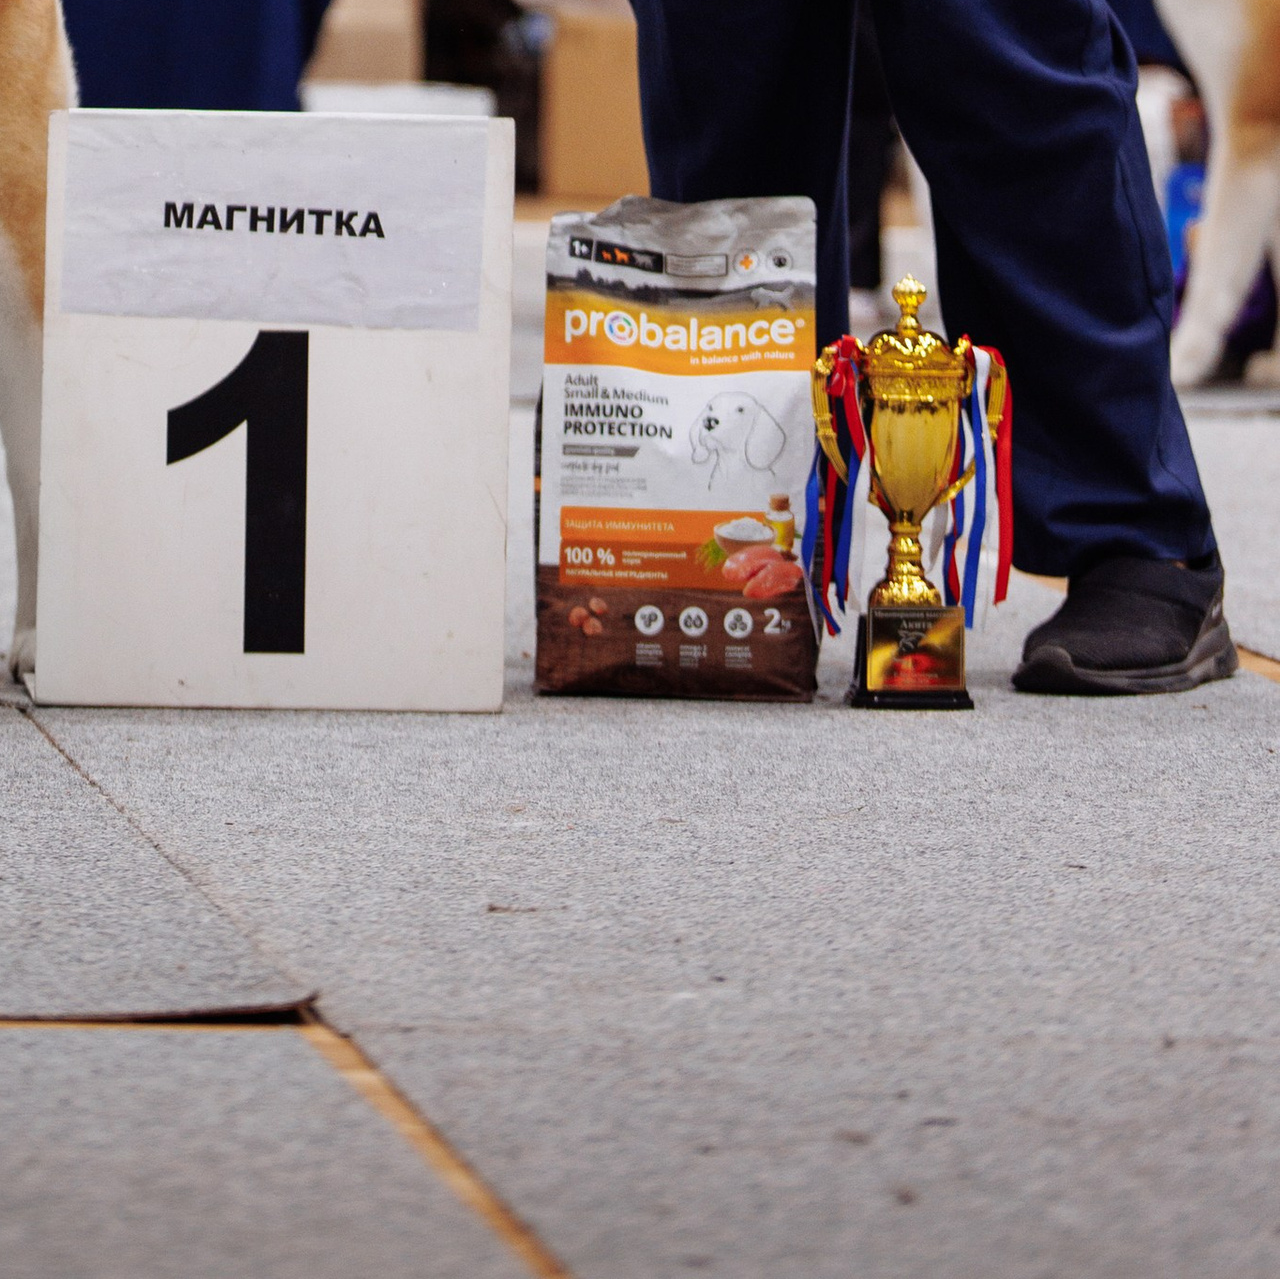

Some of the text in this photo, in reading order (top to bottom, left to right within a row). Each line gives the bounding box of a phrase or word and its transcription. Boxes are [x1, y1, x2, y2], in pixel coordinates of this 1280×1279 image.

[163, 201, 386, 239] МАГНИТКА
[564, 308, 796, 351] probalance
[690, 350, 796, 365] in balance with nature
[565, 373, 599, 386] Adult
[564, 387, 669, 405] Small & Medium
[564, 402, 644, 419] IMMUNO
[563, 421, 673, 439] PROTECTION
[166, 330, 310, 654] 1
[564, 519, 675, 532] ЗАЩИТА ИММУНИТЕТА
[564, 546, 616, 566] 100 %
